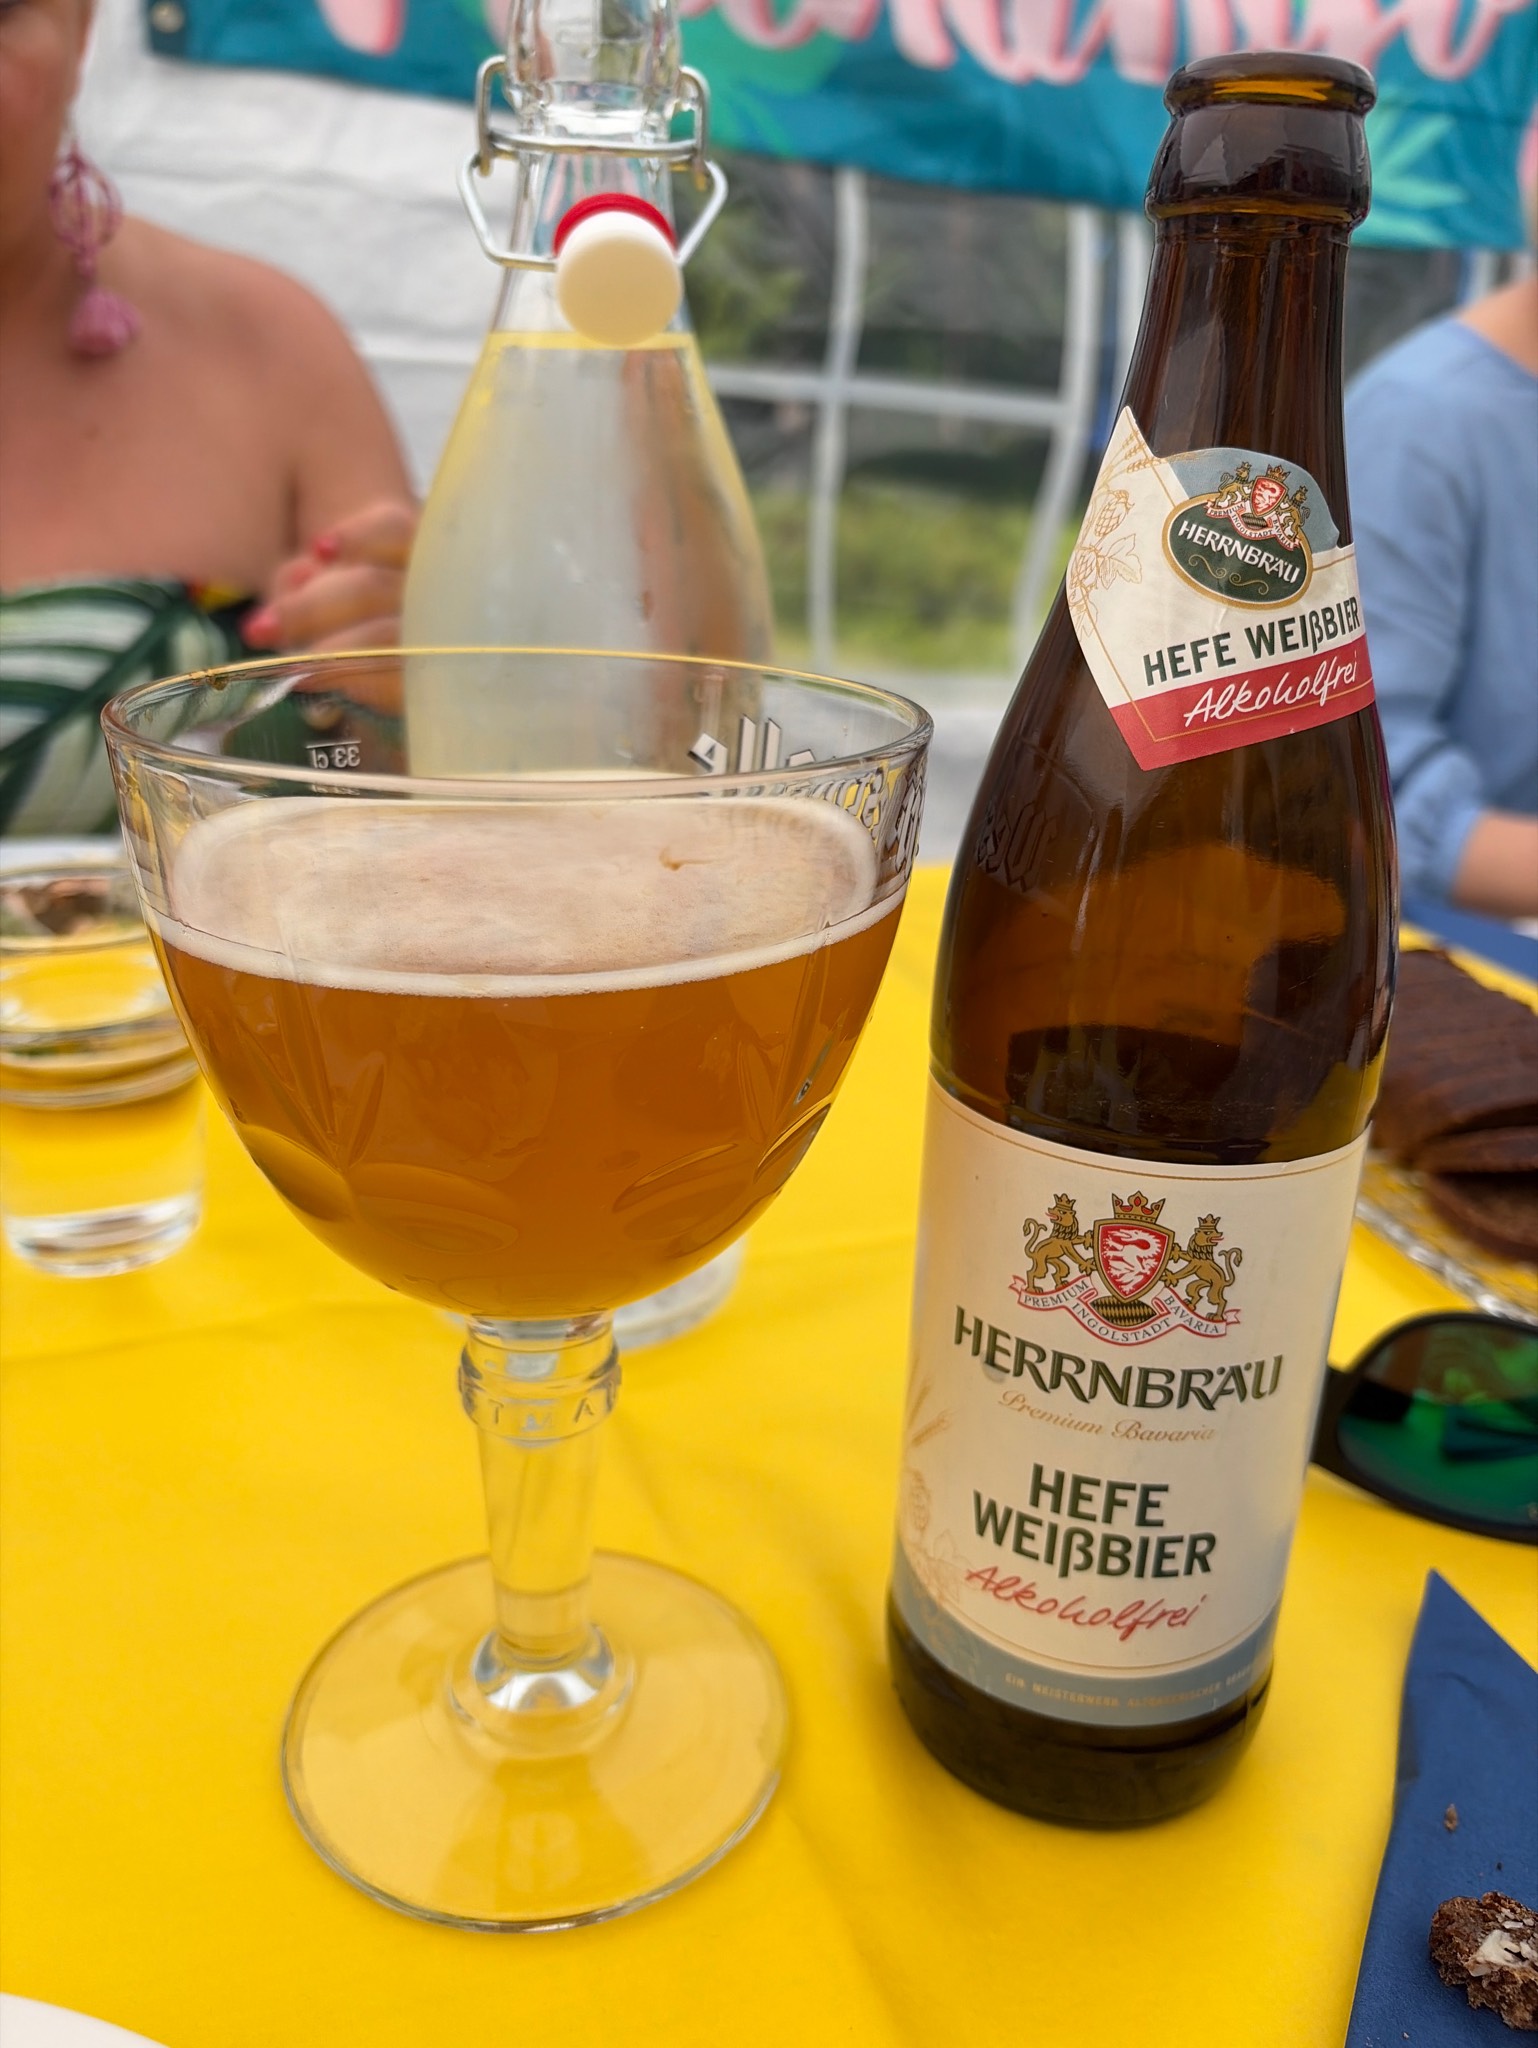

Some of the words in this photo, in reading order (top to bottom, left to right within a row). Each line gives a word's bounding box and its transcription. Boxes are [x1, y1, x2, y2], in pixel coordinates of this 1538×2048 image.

[1178, 520, 1300, 583] HERRNBRÄU
[1210, 504, 1244, 516] PREMIUM
[1231, 514, 1273, 538] INGOLSTADT
[1273, 519, 1294, 549] BAVARIA
[1143, 632, 1236, 686] HEFE
[1244, 596, 1360, 660] WEIßBIER
[1183, 650, 1357, 727] Alkoholfrei
[1023, 1280, 1089, 1308] PREMIUM
[1072, 1302, 1171, 1343] INGOLSTADT
[1164, 1294, 1220, 1334] BAVARIA
[955, 1305, 1283, 1411] HERRNBRÄU
[998, 1389, 1104, 1436] Premium
[1111, 1418, 1216, 1442] Bavaria
[1029, 1463, 1169, 1527] HEFE
[973, 1489, 1216, 1579] WEIßBIER
[965, 1565, 1207, 1642] Alkoholfrei
